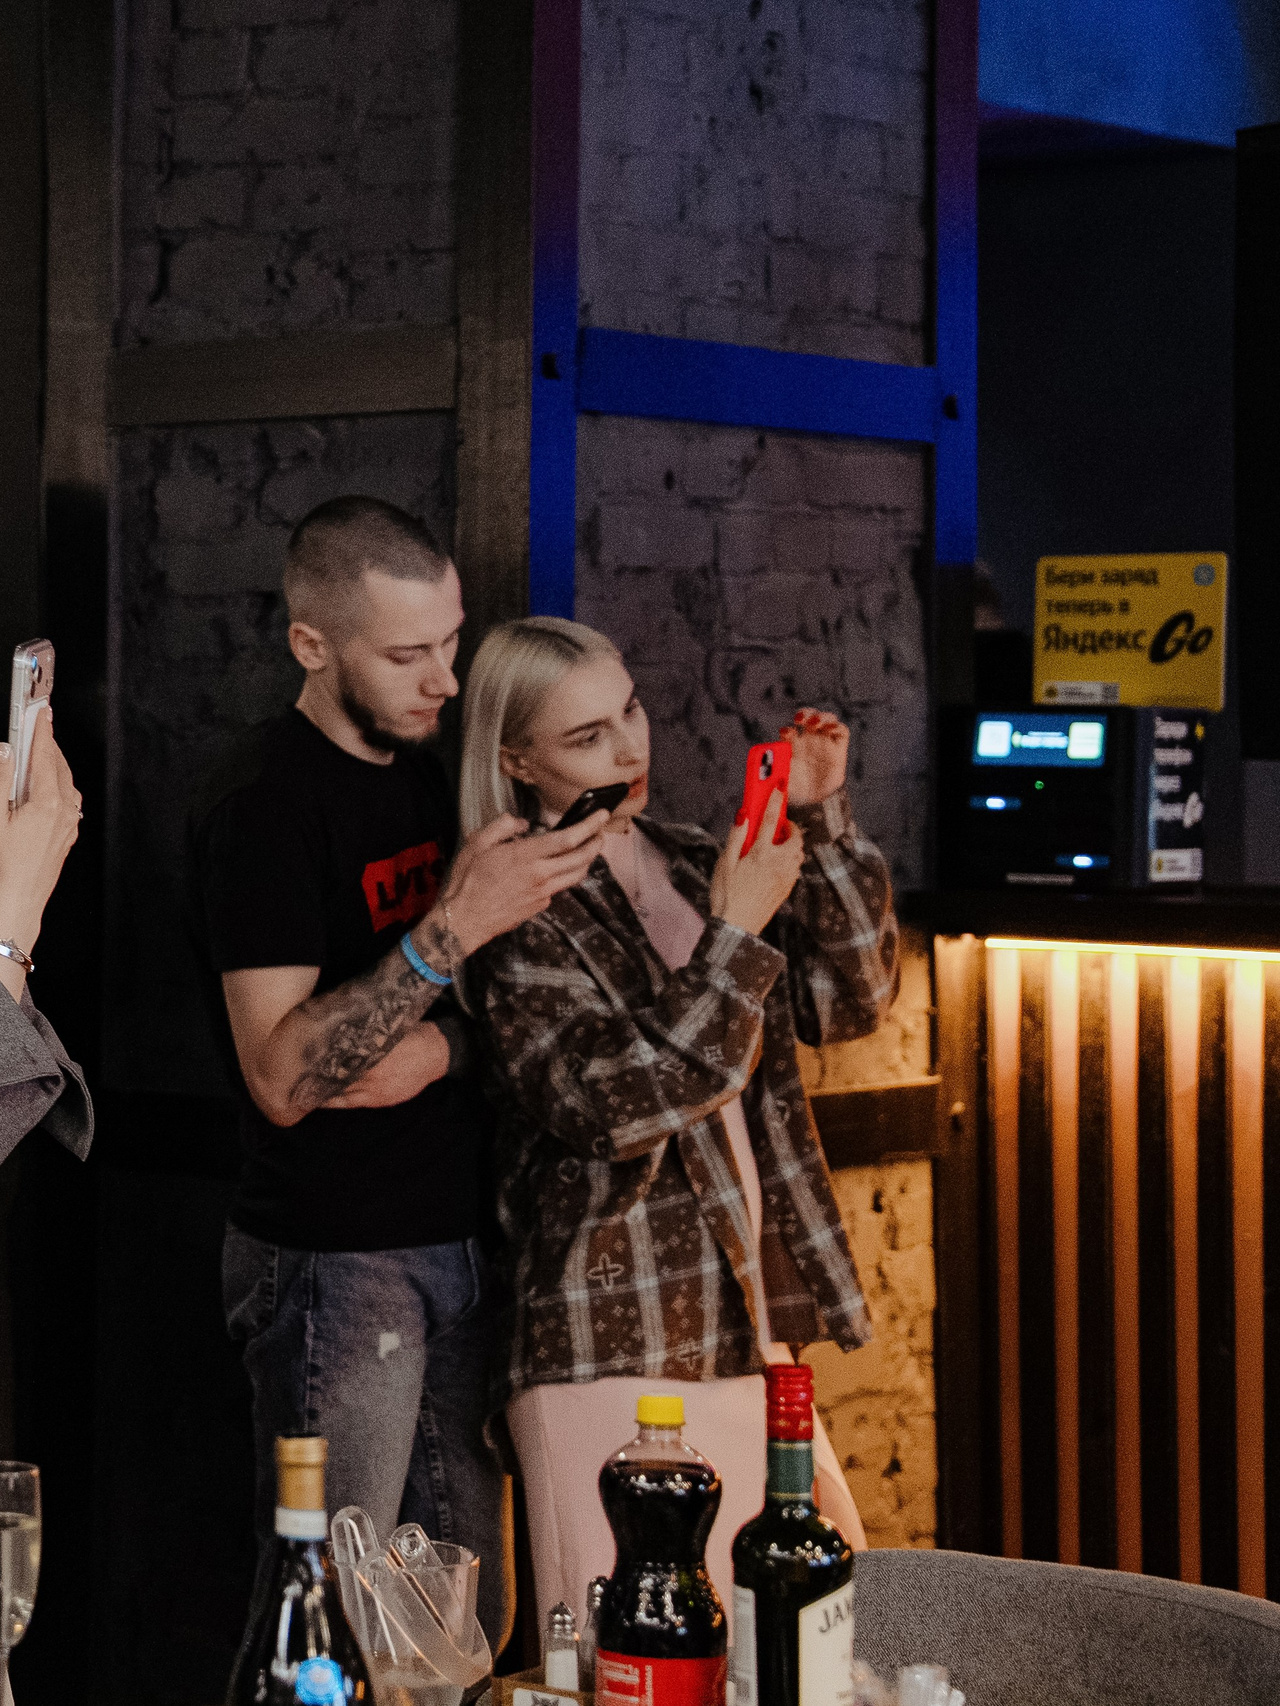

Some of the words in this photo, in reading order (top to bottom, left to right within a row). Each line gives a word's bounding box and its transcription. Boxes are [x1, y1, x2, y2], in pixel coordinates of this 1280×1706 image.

[1045, 565, 1094, 588] Бери
[1101, 568, 1159, 587] заряд
[1046, 599, 1113, 616] теперь
[1119, 599, 1129, 612] в
[1044, 623, 1146, 654] Яндекс
[1149, 610, 1213, 665] Go
